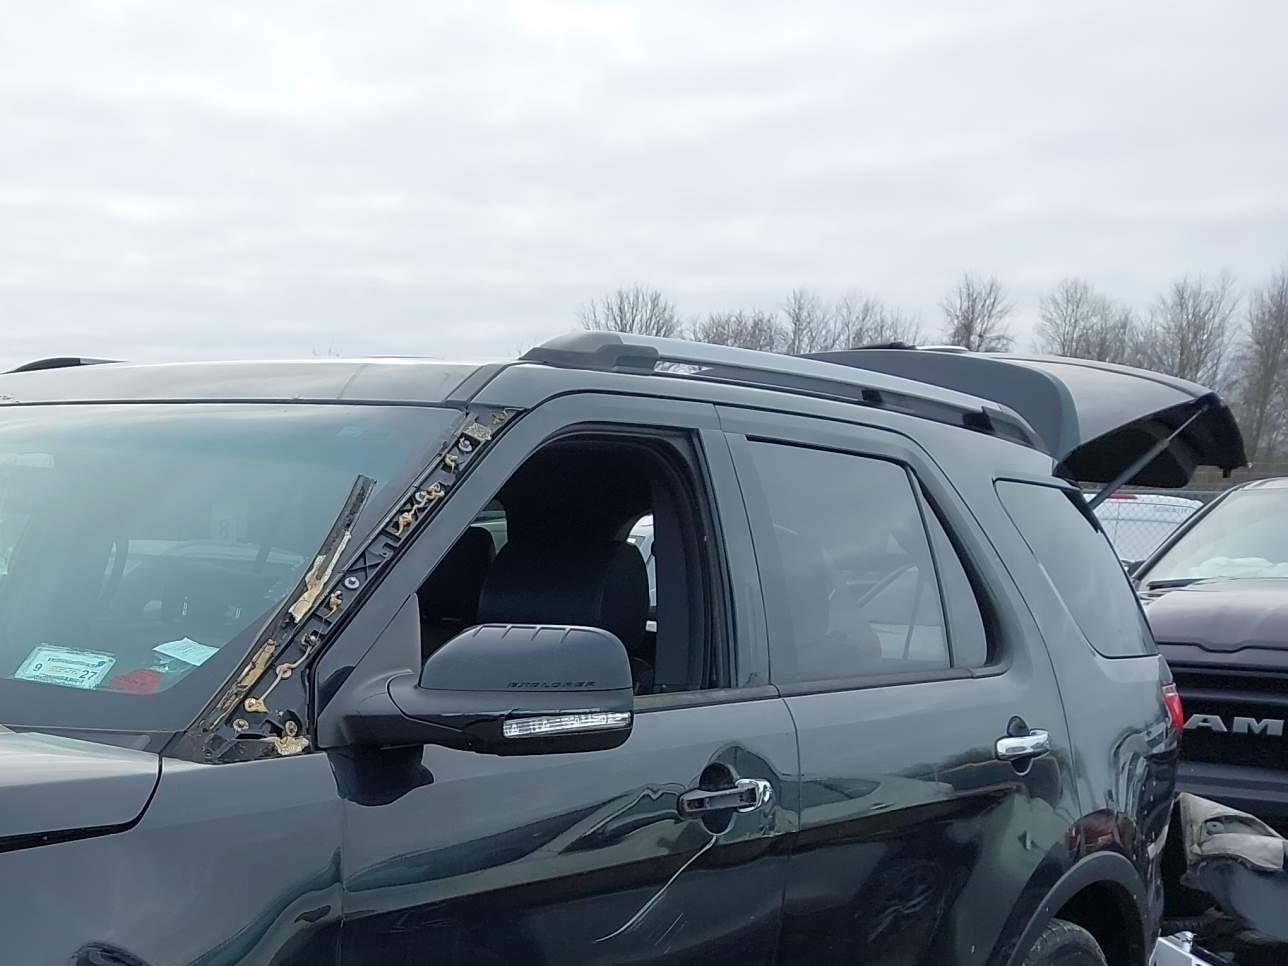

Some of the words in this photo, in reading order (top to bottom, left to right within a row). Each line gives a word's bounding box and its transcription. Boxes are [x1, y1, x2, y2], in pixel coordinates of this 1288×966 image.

[32, 663, 43, 672] 9
[78, 669, 98, 680] 27
[1183, 713, 1285, 736] AM
